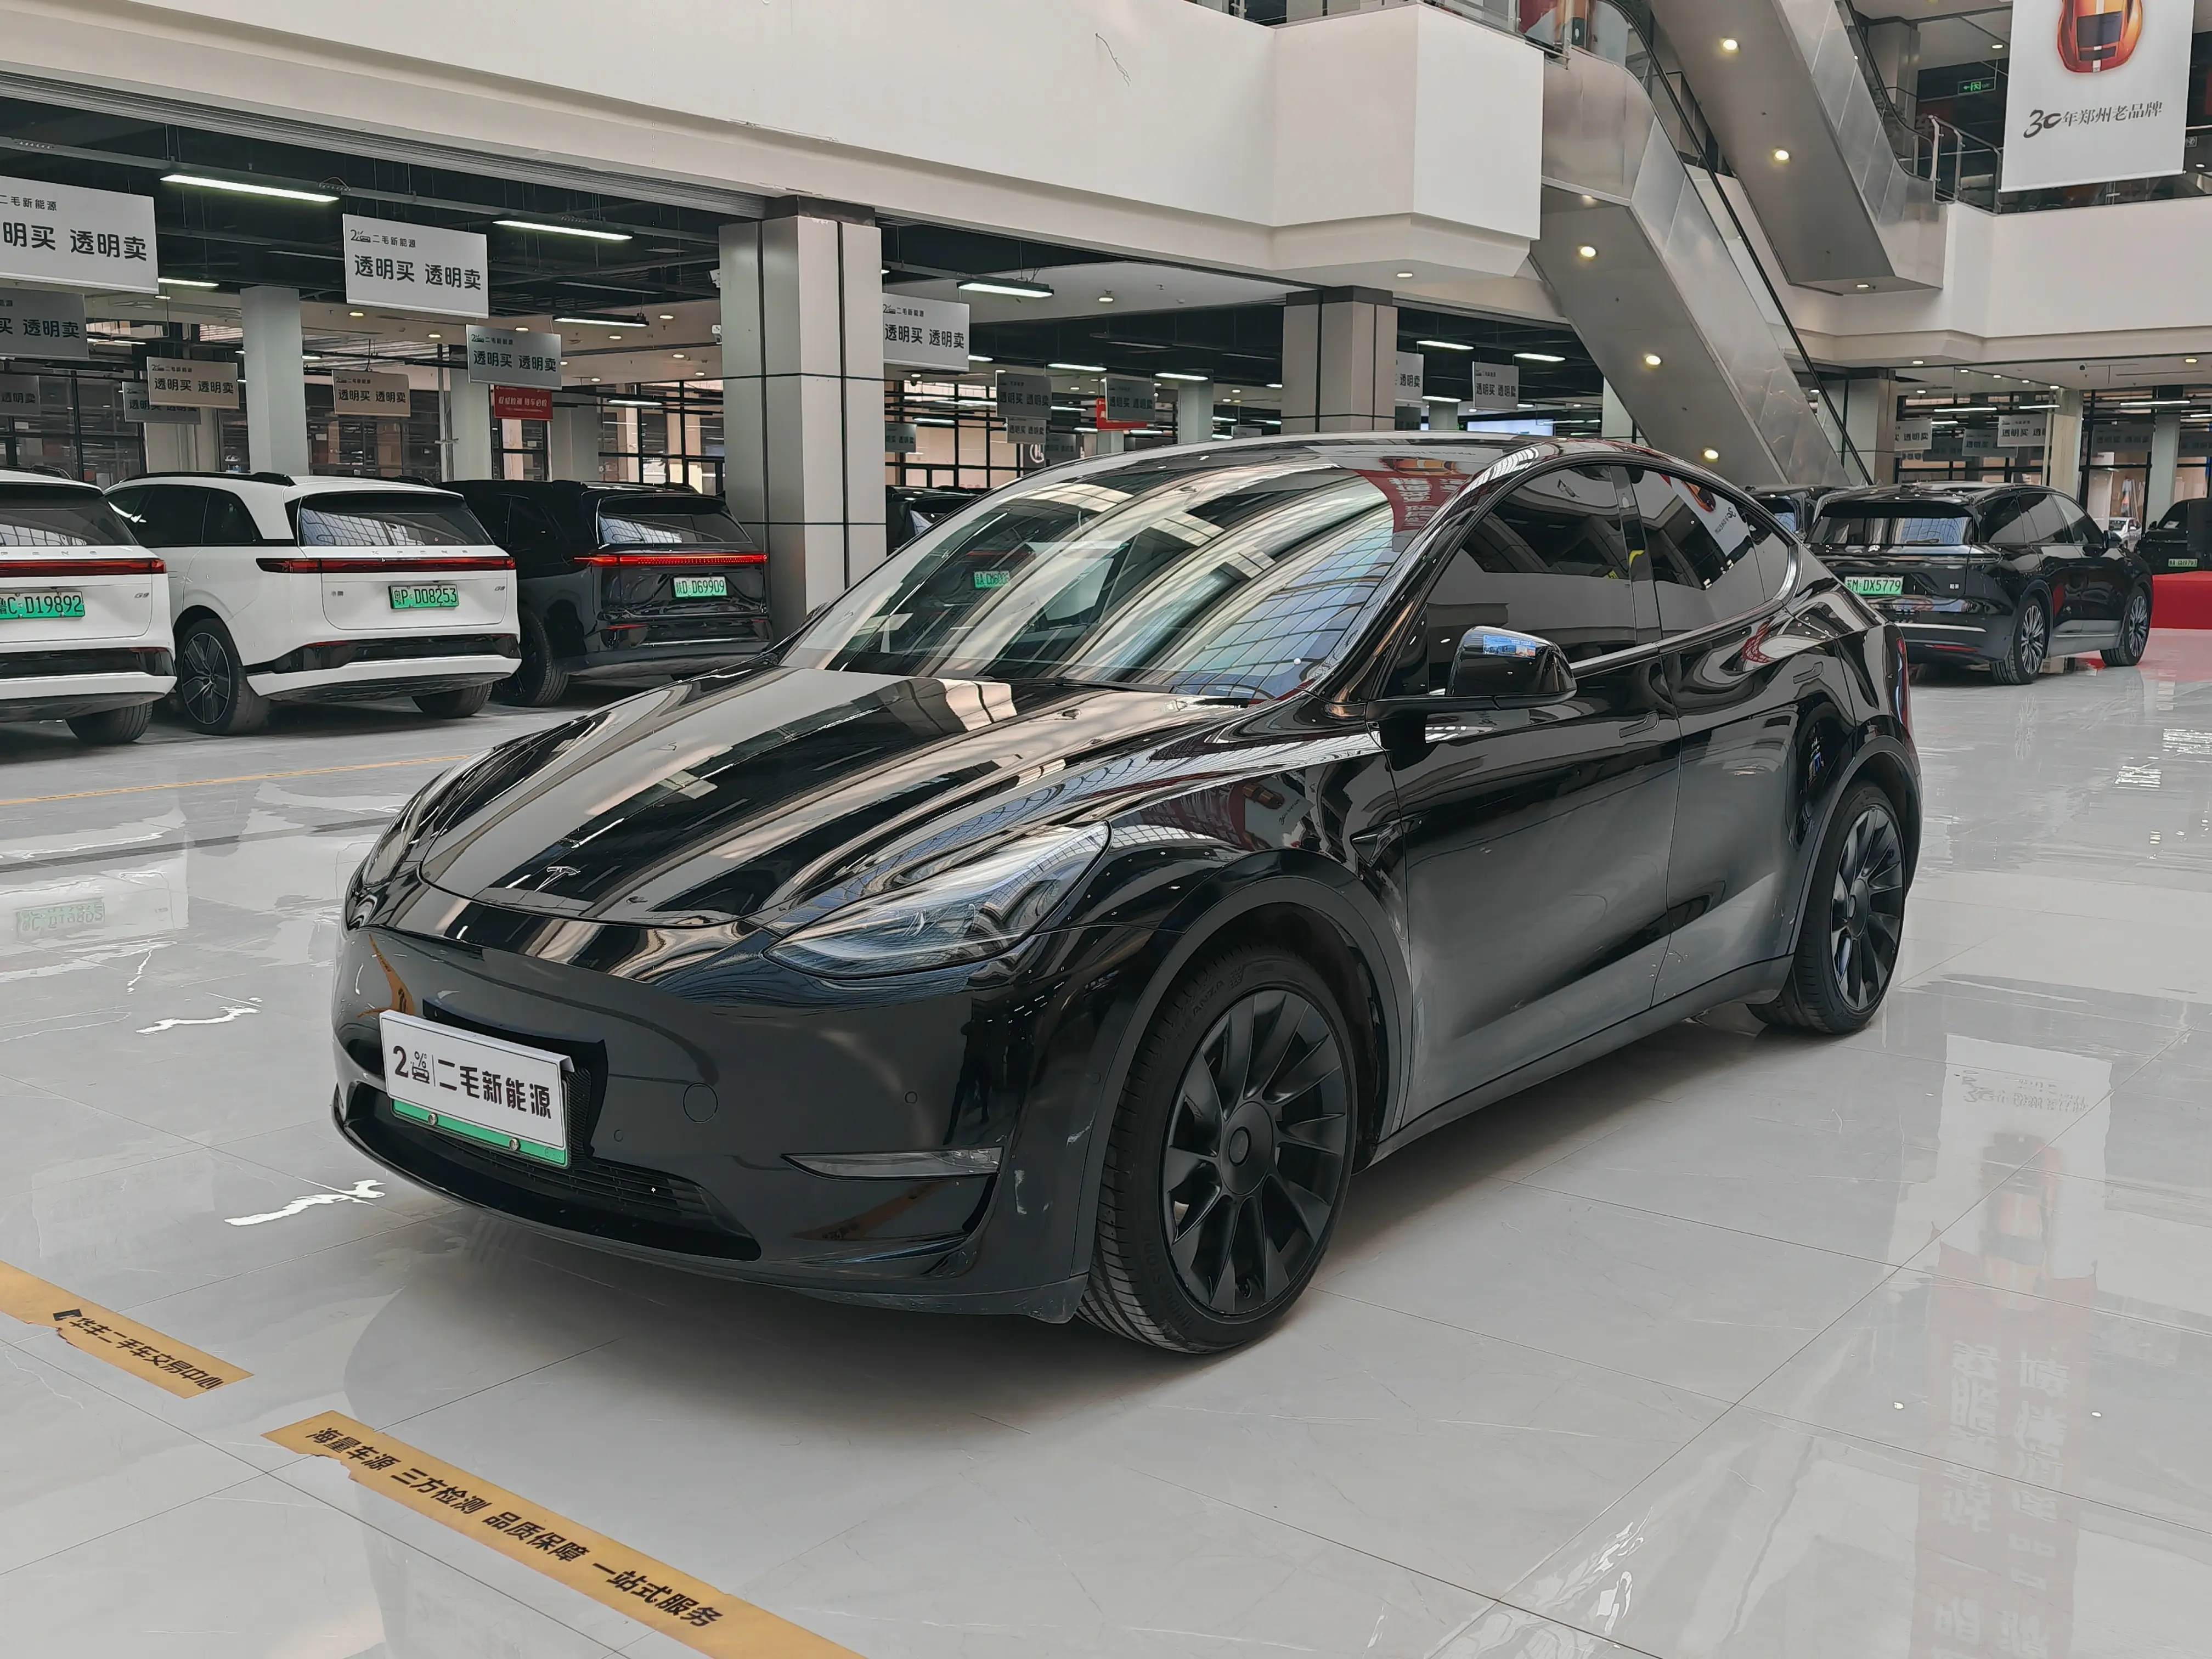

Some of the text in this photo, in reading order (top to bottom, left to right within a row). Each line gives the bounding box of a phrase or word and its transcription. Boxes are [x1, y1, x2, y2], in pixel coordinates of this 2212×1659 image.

[2023, 100, 2163, 138] 30年郑州老品牌
[70, 228, 146, 262] 透明卖
[372, 234, 416, 249] 二毛新能源
[354, 253, 482, 291] 透明买 透明卖
[23, 318, 80, 339] 透明卖
[884, 323, 964, 349] 透明买 透明卖
[473, 350, 556, 372] 透明买 透明卖
[154, 377, 192, 392] 透明买
[198, 380, 234, 394] 透明卖
[338, 388, 407, 403] 透明买 透明卖
[437, 1058, 552, 1120] 二毛新能源
[305, 1427, 724, 1627] 海量车源 三方检测 品质保障 一站式服务
